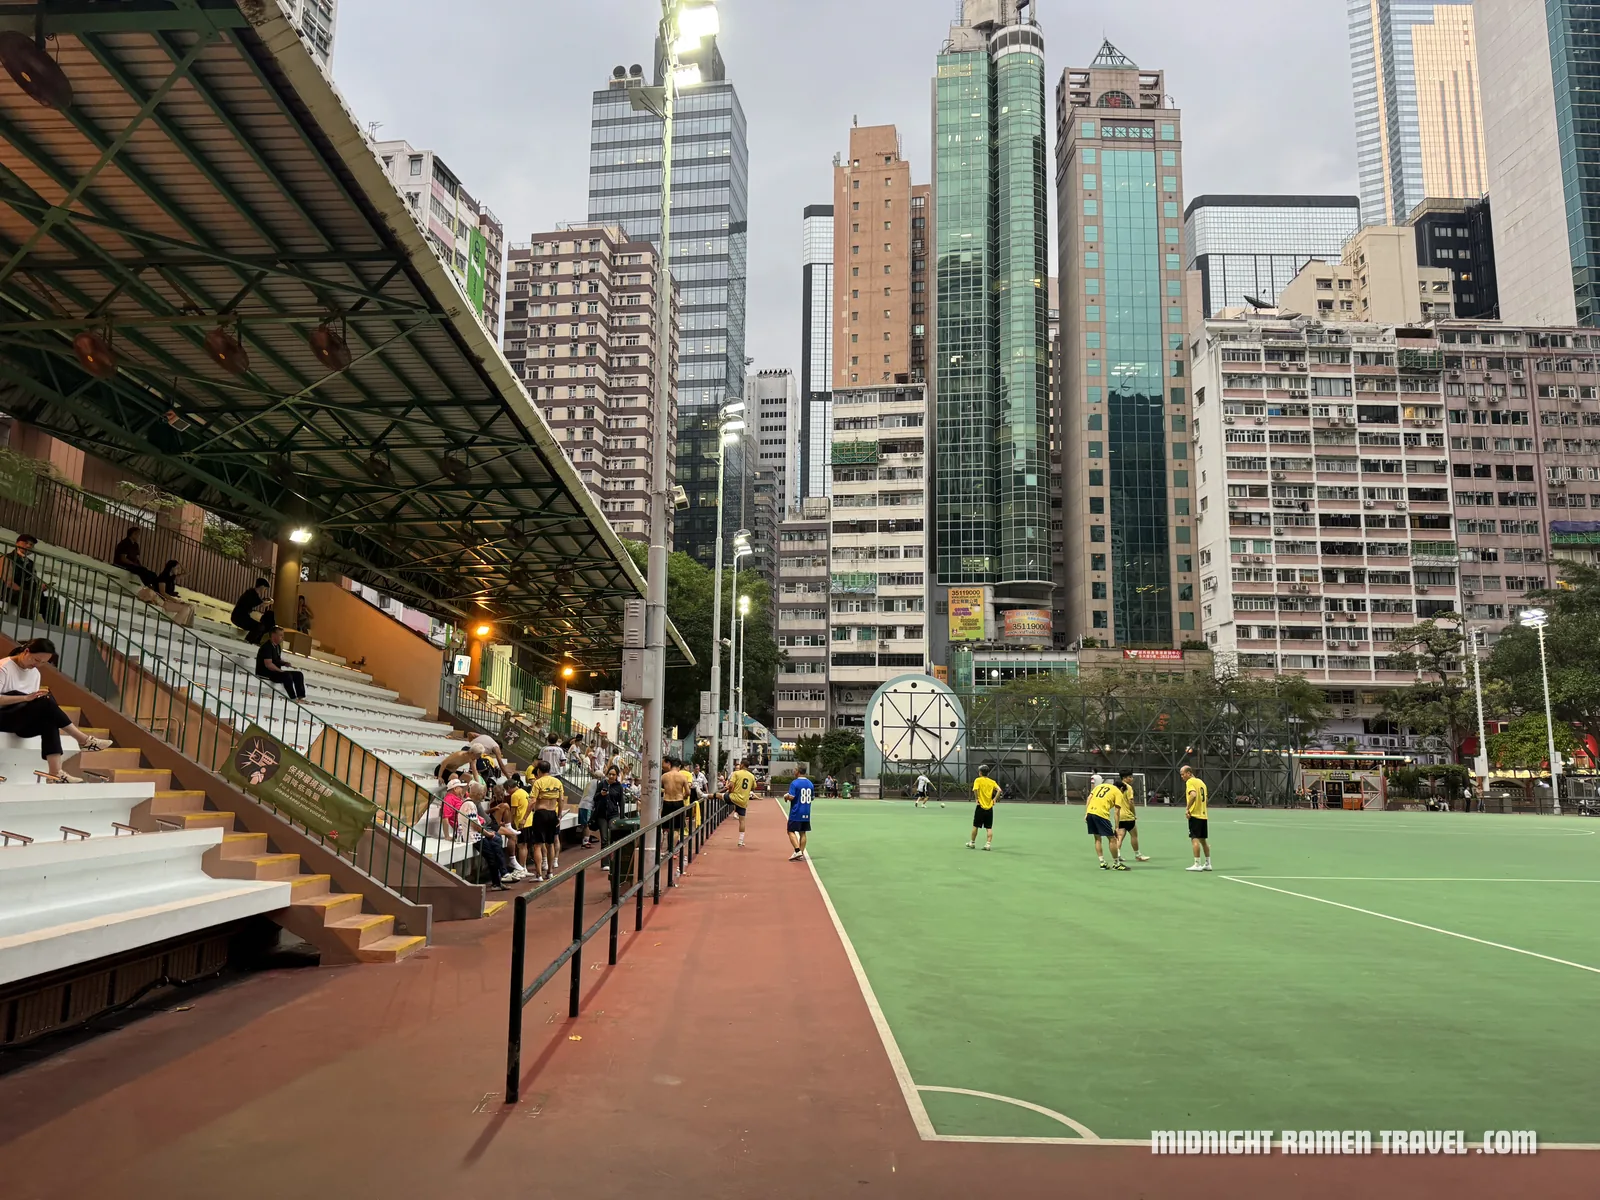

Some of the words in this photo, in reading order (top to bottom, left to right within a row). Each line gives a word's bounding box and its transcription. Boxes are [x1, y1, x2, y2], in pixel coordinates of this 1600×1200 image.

[282, 774, 321, 802] 請降低音量
[288, 765, 334, 798] 保持環境清靜
[742, 778, 749, 790] 6
[800, 787, 812, 804] 88
[1096, 786, 1110, 798] 13
[289, 796, 301, 805] keep
[309, 809, 321, 818] voice
